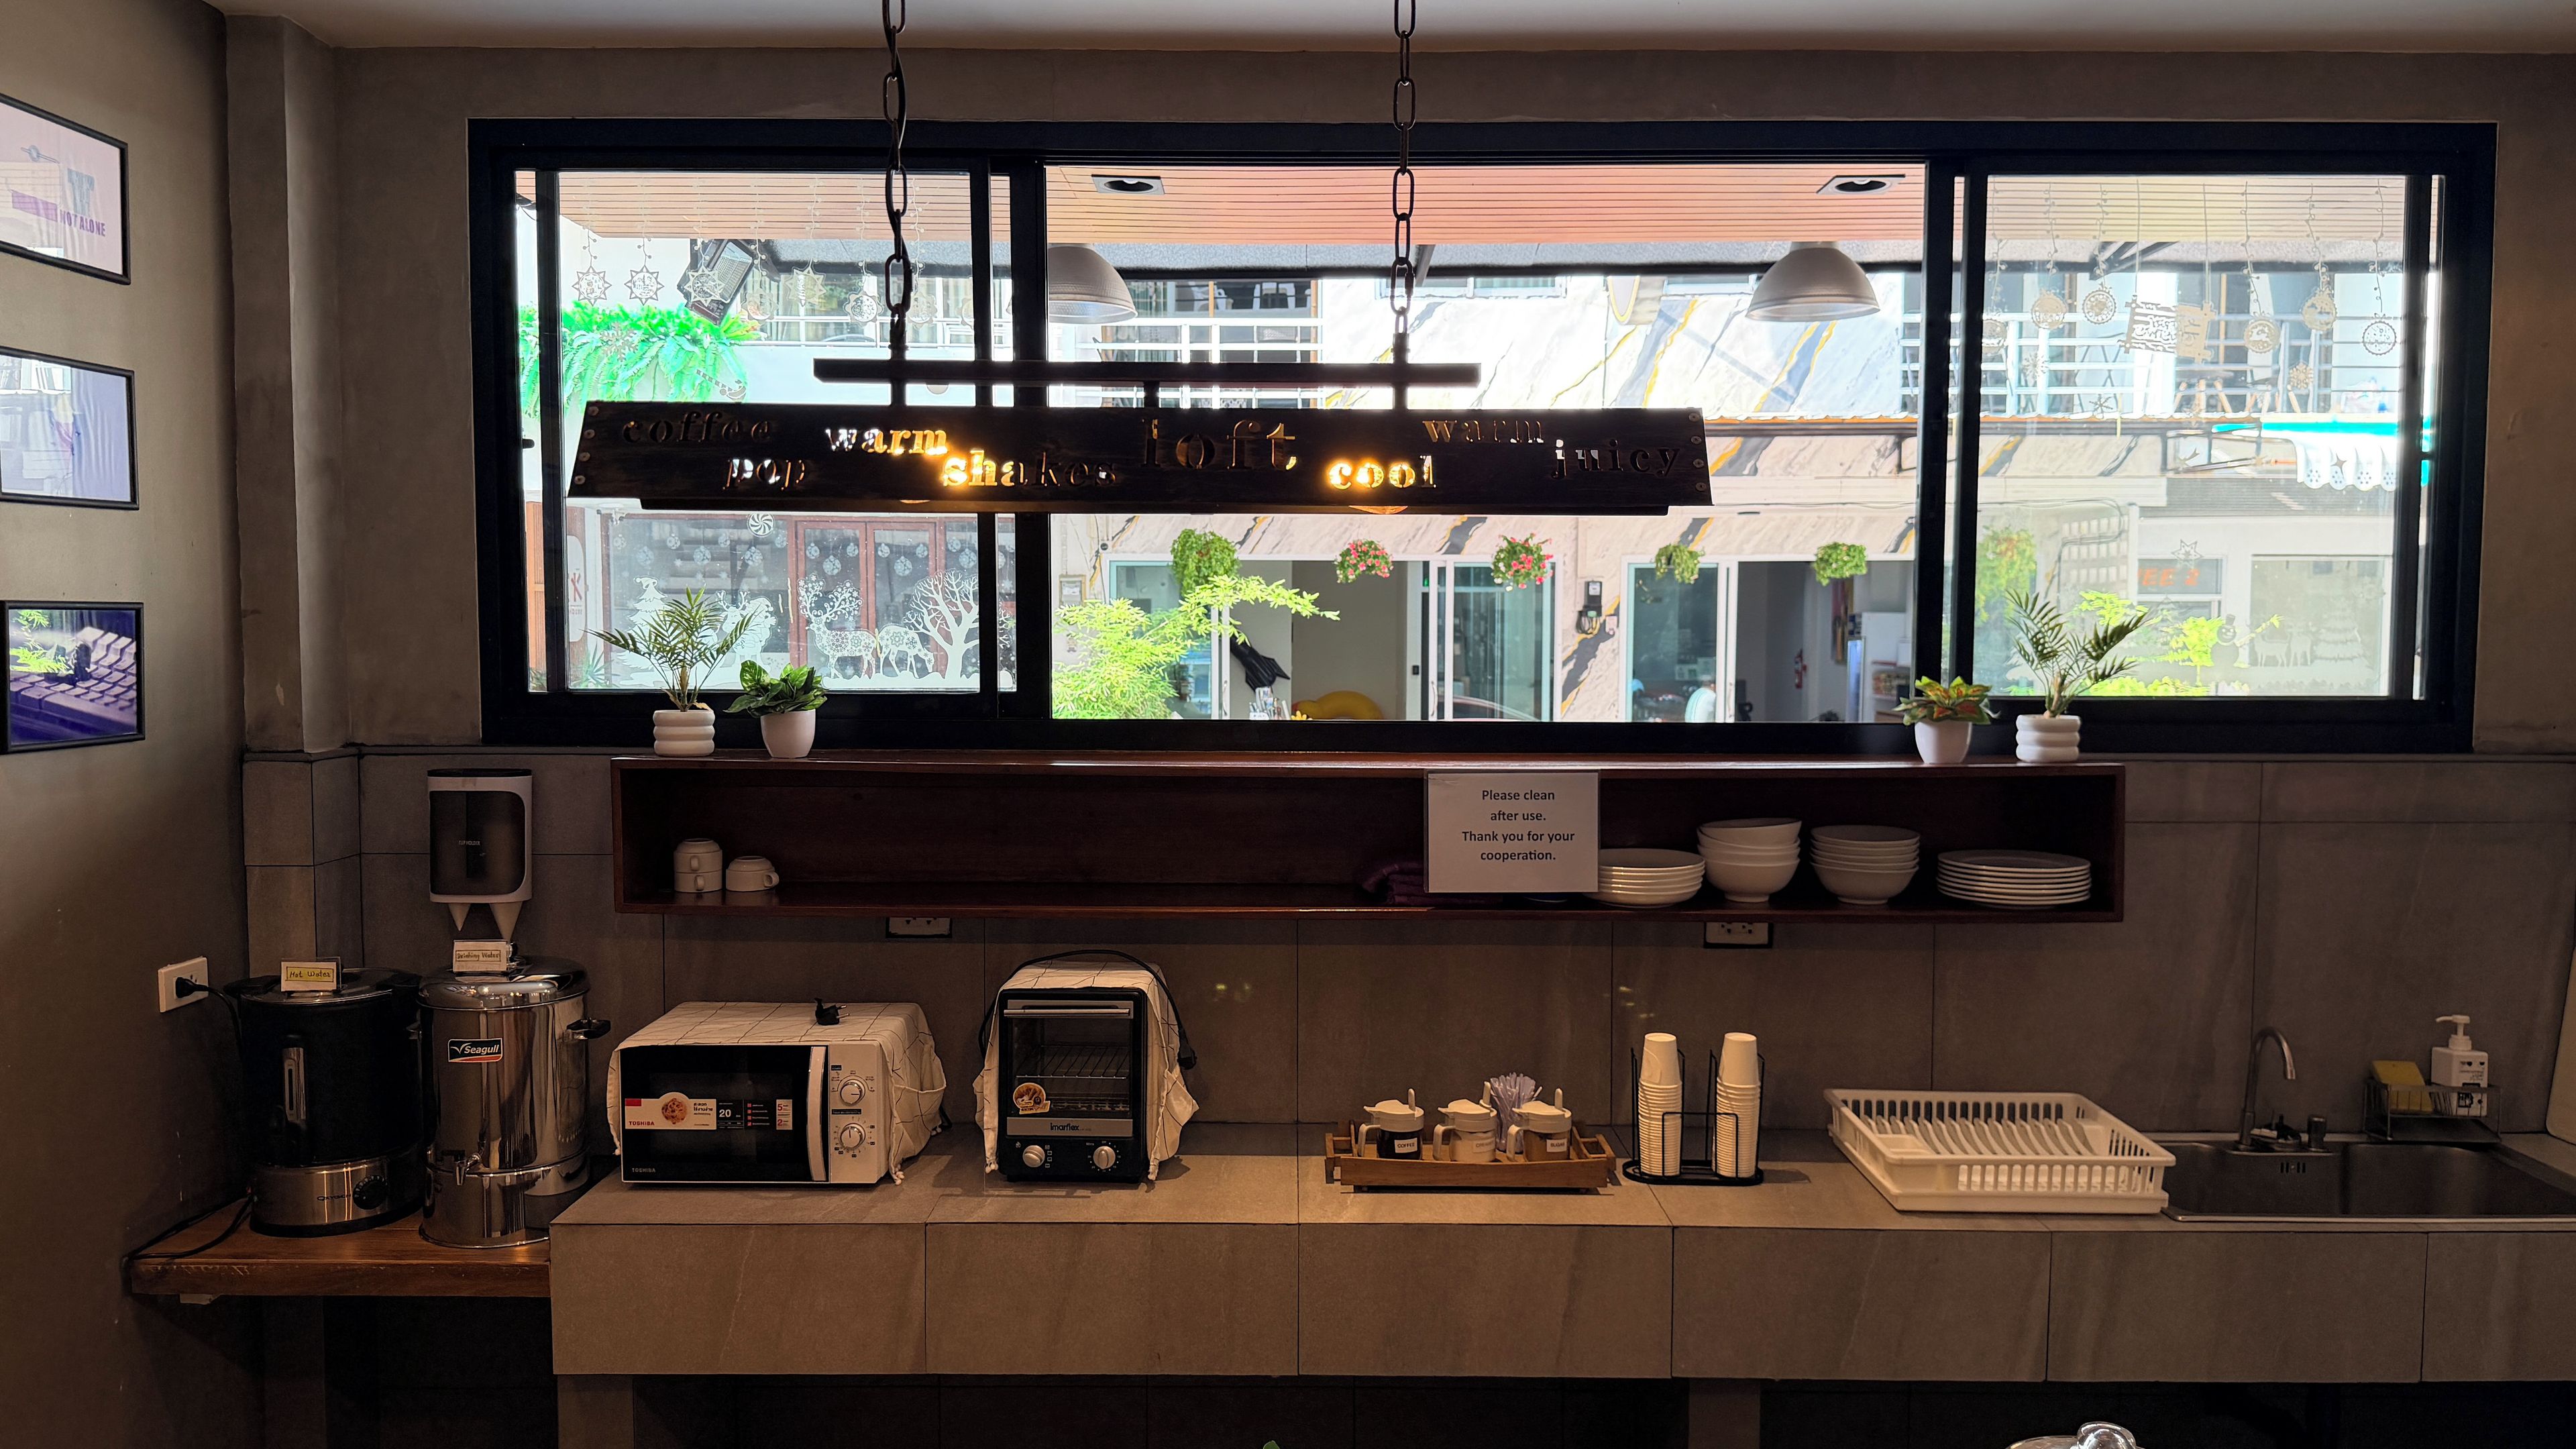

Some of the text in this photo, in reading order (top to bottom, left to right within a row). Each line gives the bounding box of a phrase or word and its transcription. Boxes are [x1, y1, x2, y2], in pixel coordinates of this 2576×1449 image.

[80, 216, 106, 237] ALONE
[622, 411, 771, 443] coffee
[1423, 419, 1545, 445] warm
[825, 426, 949, 457] warm
[1140, 418, 1297, 470] loft
[1553, 440, 1680, 479] juicy
[722, 457, 806, 490] pop
[942, 449, 1117, 488] shakes
[1328, 454, 1437, 490] cool
[1482, 790, 1555, 800] Please clean
[1491, 810, 1546, 821] after use.
[1462, 830, 1575, 843] Thank you for your
[1481, 851, 1556, 862] cooperation.
[457, 951, 499, 961] Drinking Water
[464, 1044, 499, 1055] Seagull
[719, 1109, 732, 1118] 20
[777, 1104, 783, 1112] 5
[1051, 1122, 1079, 1131] imarflex
